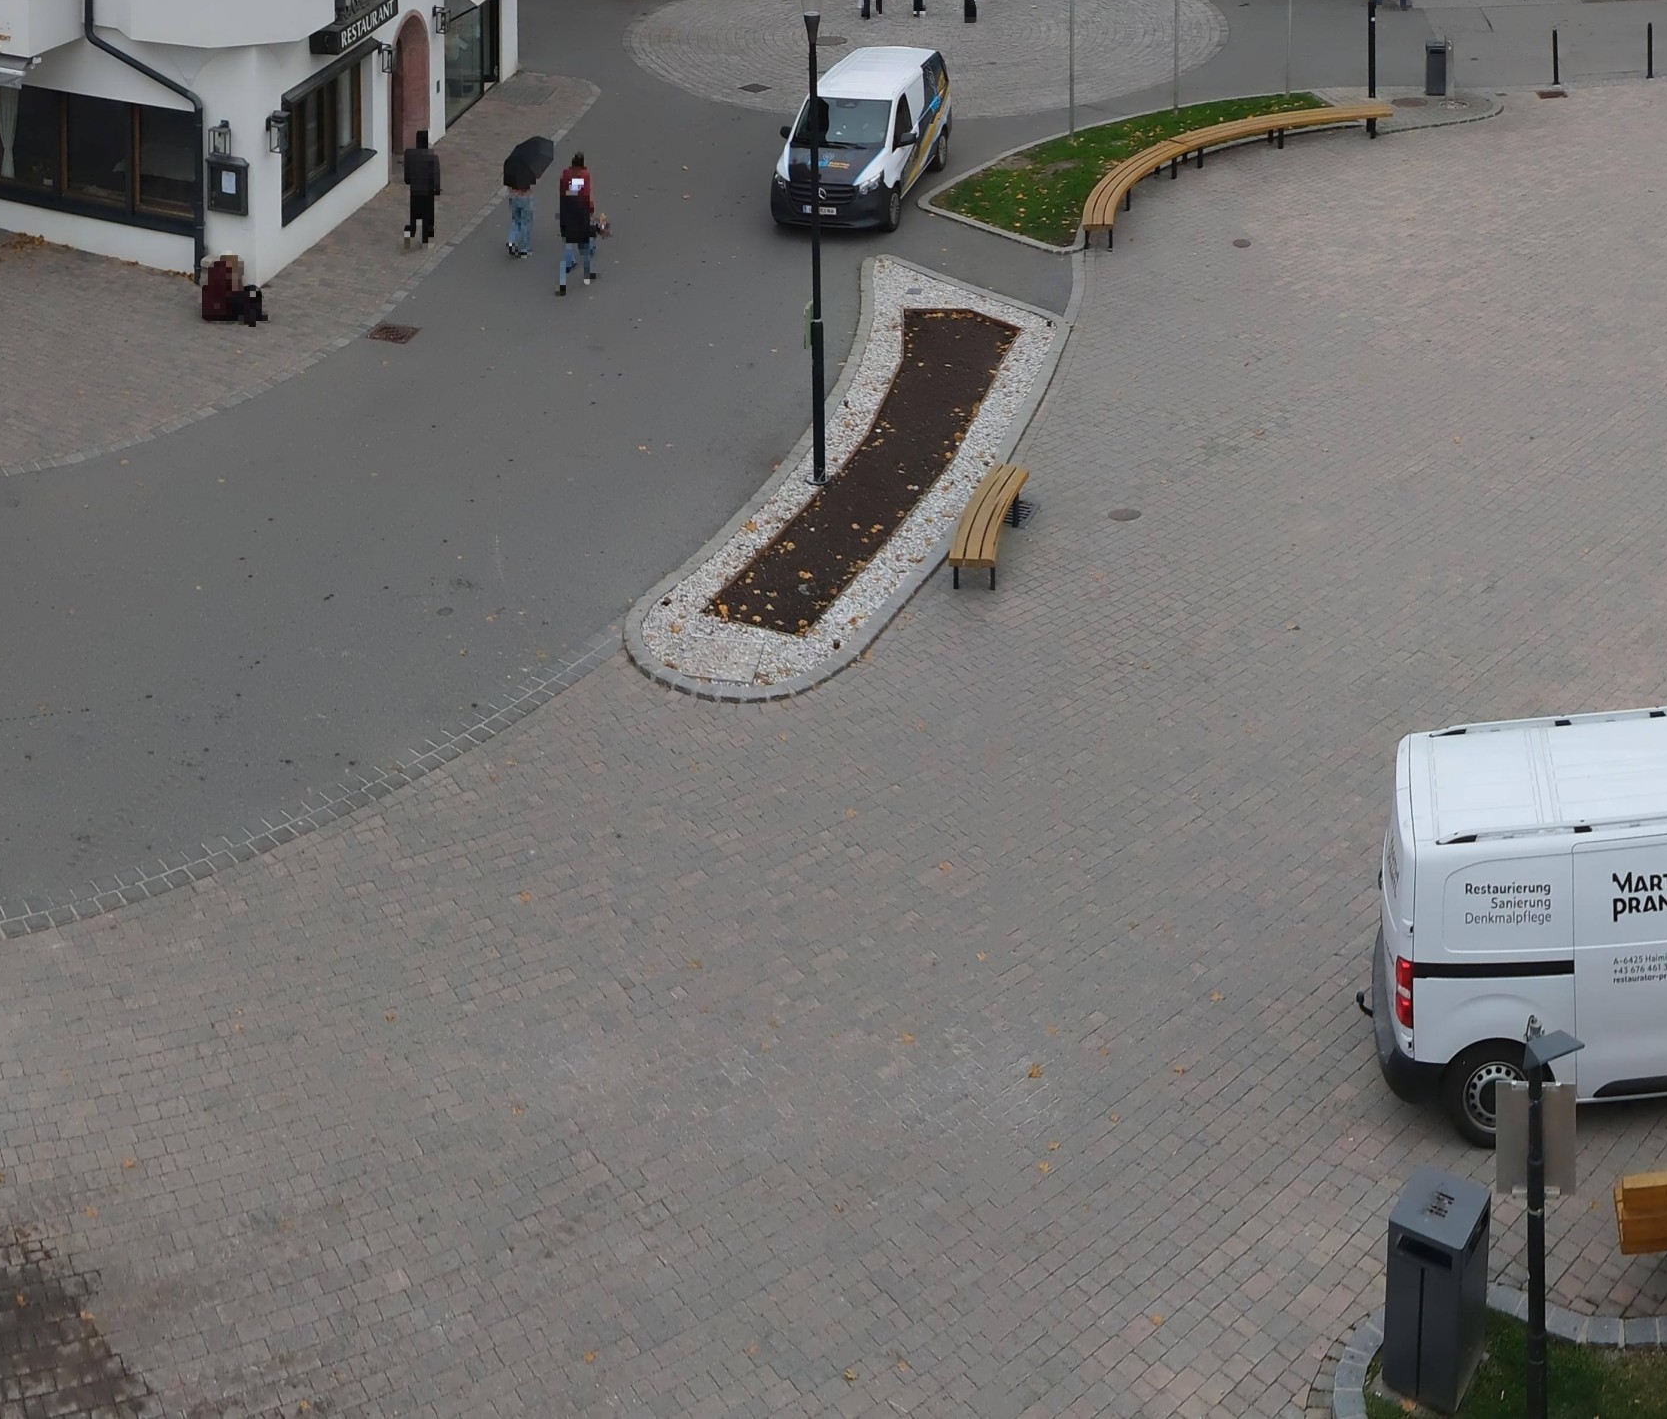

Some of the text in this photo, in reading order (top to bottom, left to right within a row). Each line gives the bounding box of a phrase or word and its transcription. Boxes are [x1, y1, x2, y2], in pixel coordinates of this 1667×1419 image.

[341, 0, 394, 48] RESTAURANT
[1465, 882, 1552, 896] Restaurierung
[1491, 897, 1552, 910] Sanierung
[1465, 912, 1552, 925] Denkmalpflege
[1613, 954, 1642, 965] A-6425
[1613, 965, 1628, 975] +43
[1631, 964, 1646, 974] 676
[1647, 963, 1662, 973] 461
